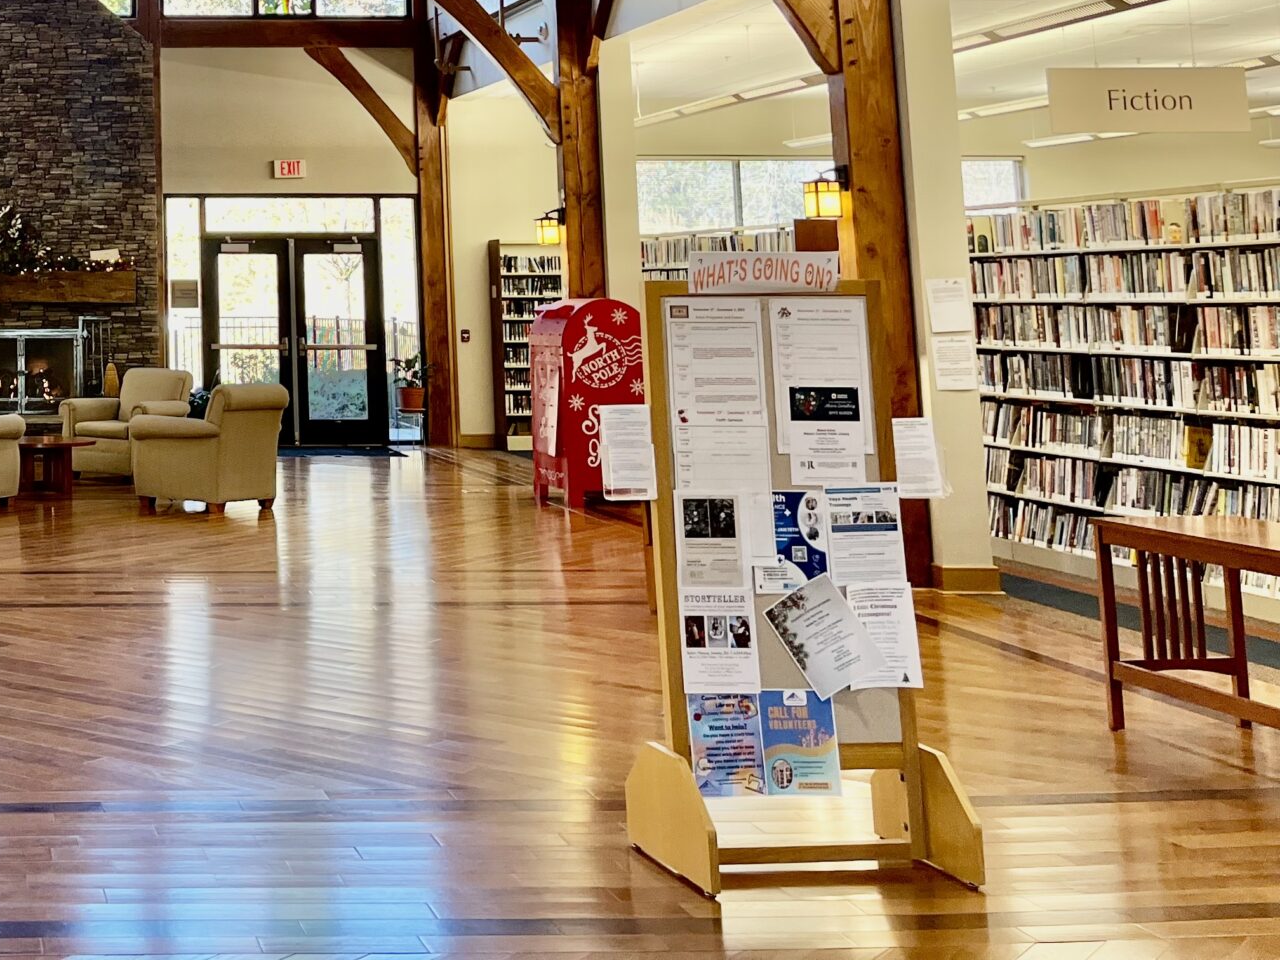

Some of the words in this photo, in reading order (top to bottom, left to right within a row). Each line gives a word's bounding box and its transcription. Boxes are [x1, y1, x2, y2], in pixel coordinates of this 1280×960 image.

[1107, 89, 1193, 111] Fiction
[280, 160, 301, 176] EXIT
[693, 258, 748, 293] WHAT'S
[752, 257, 800, 283] GOING
[804, 263, 833, 292] ON?
[581, 349, 620, 377] NORTH
[592, 361, 620, 383] POLE
[684, 594, 746, 603] STORYTELLER
[768, 706, 789, 719] CALL
[791, 706, 808, 719] FOR
[768, 720, 817, 730] VOLUNTEERS
